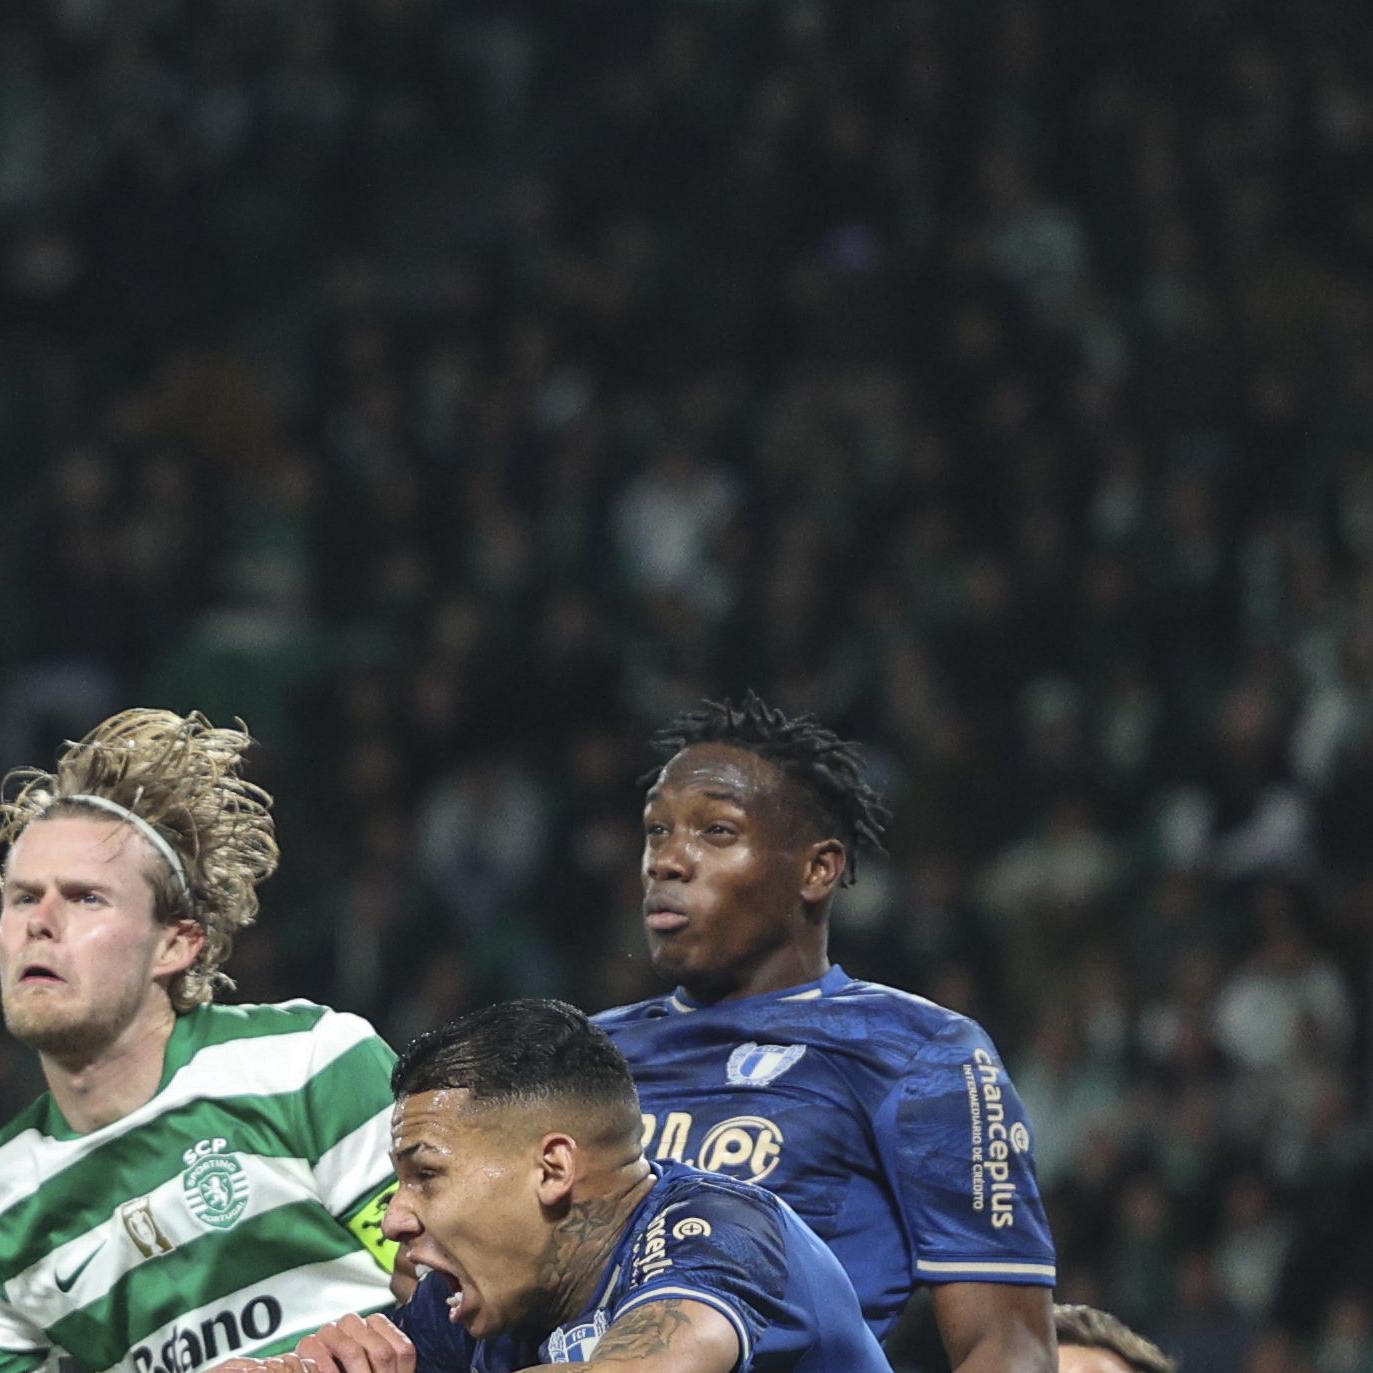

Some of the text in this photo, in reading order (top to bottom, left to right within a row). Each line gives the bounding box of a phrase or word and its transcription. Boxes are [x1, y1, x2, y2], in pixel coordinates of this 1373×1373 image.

[182, 1137, 228, 1166] SCP
[973, 1047, 1016, 1230] chanceplus
[187, 1158, 238, 1188] SPORTING
